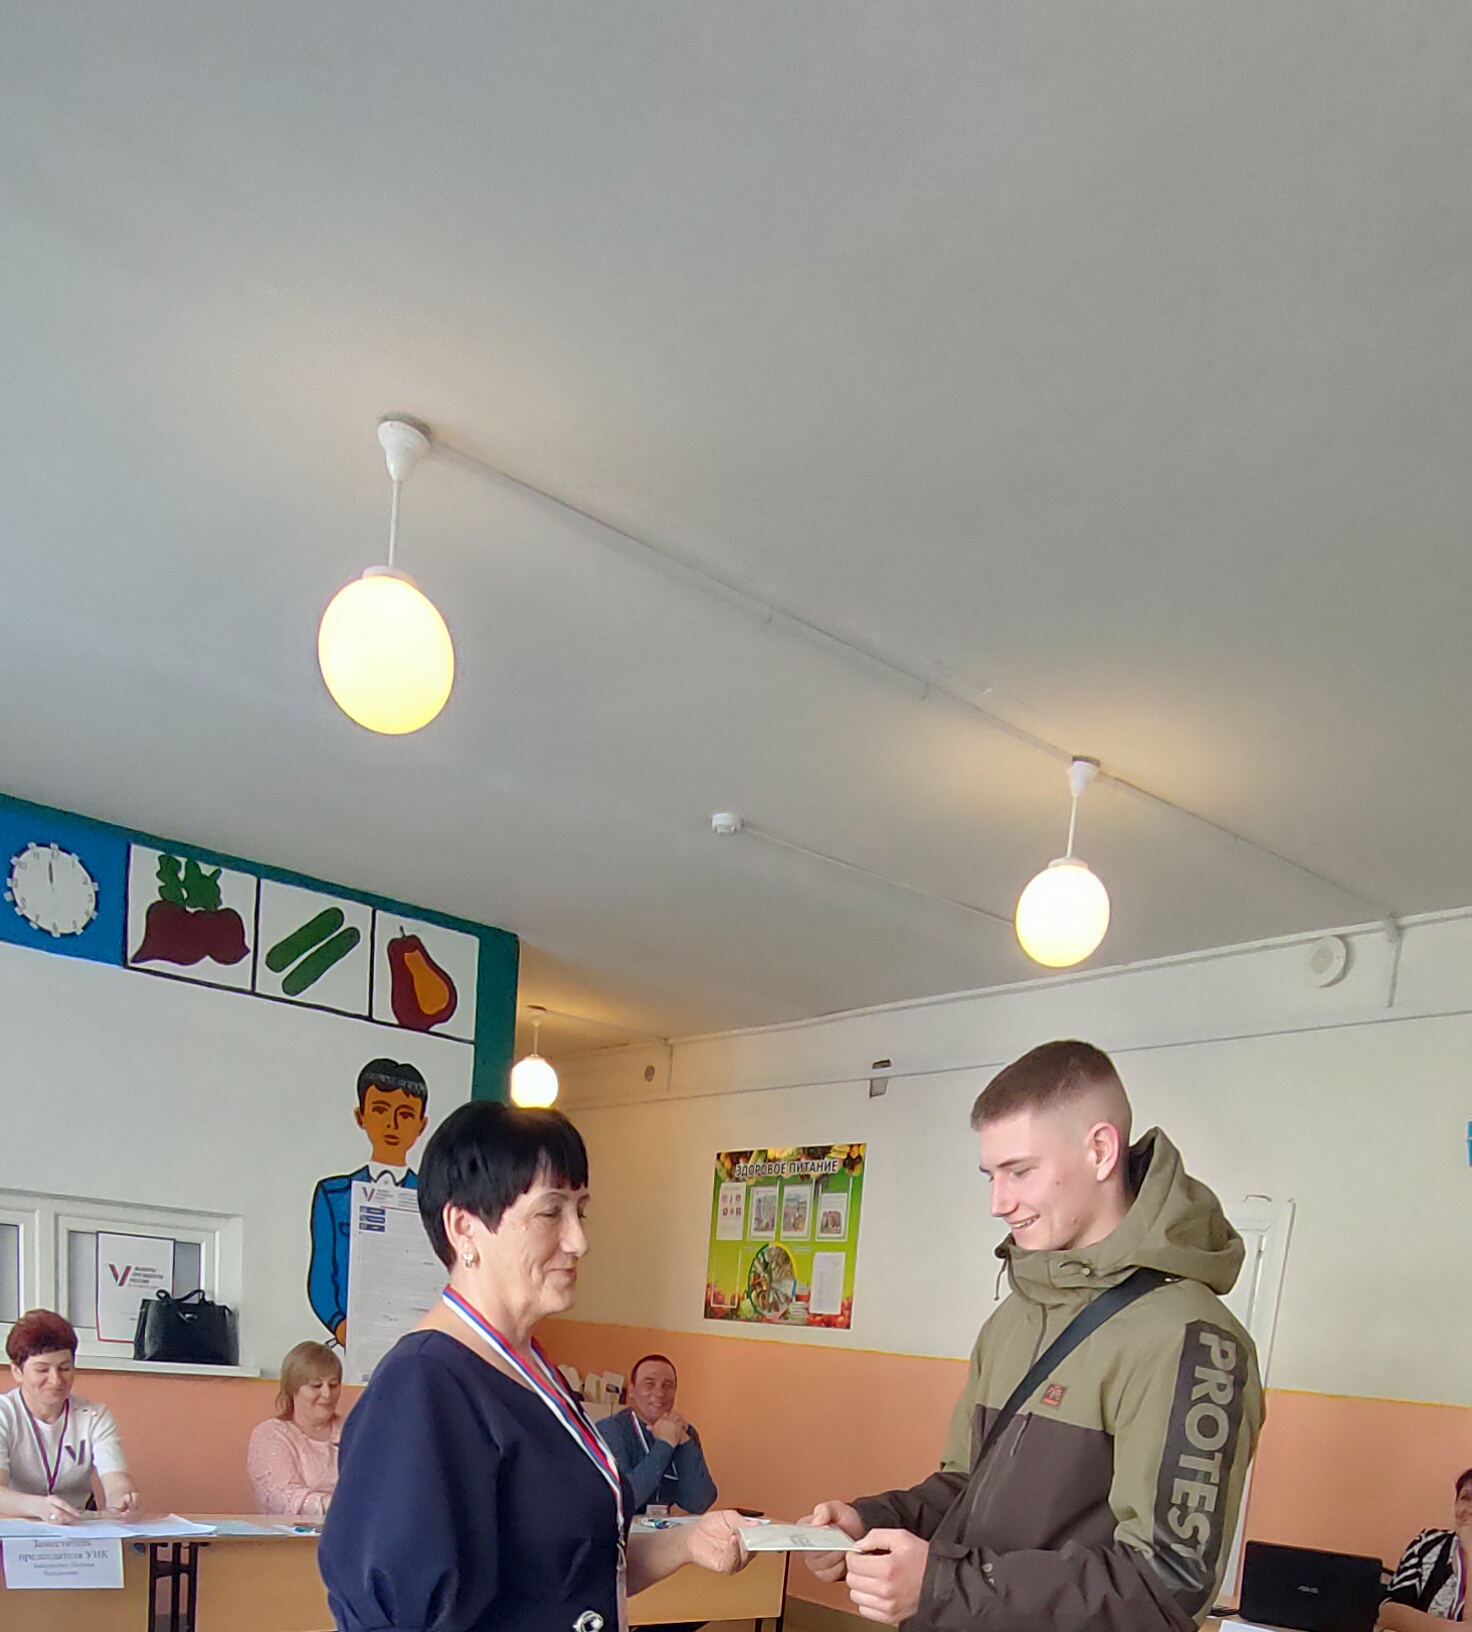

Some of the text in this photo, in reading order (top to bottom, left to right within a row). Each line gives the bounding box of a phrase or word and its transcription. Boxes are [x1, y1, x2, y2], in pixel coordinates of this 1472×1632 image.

[736, 1160, 838, 1177] ЗДОРОВОЕ ПИТАНИЕ
[85, 1549, 109, 1560] УИК
